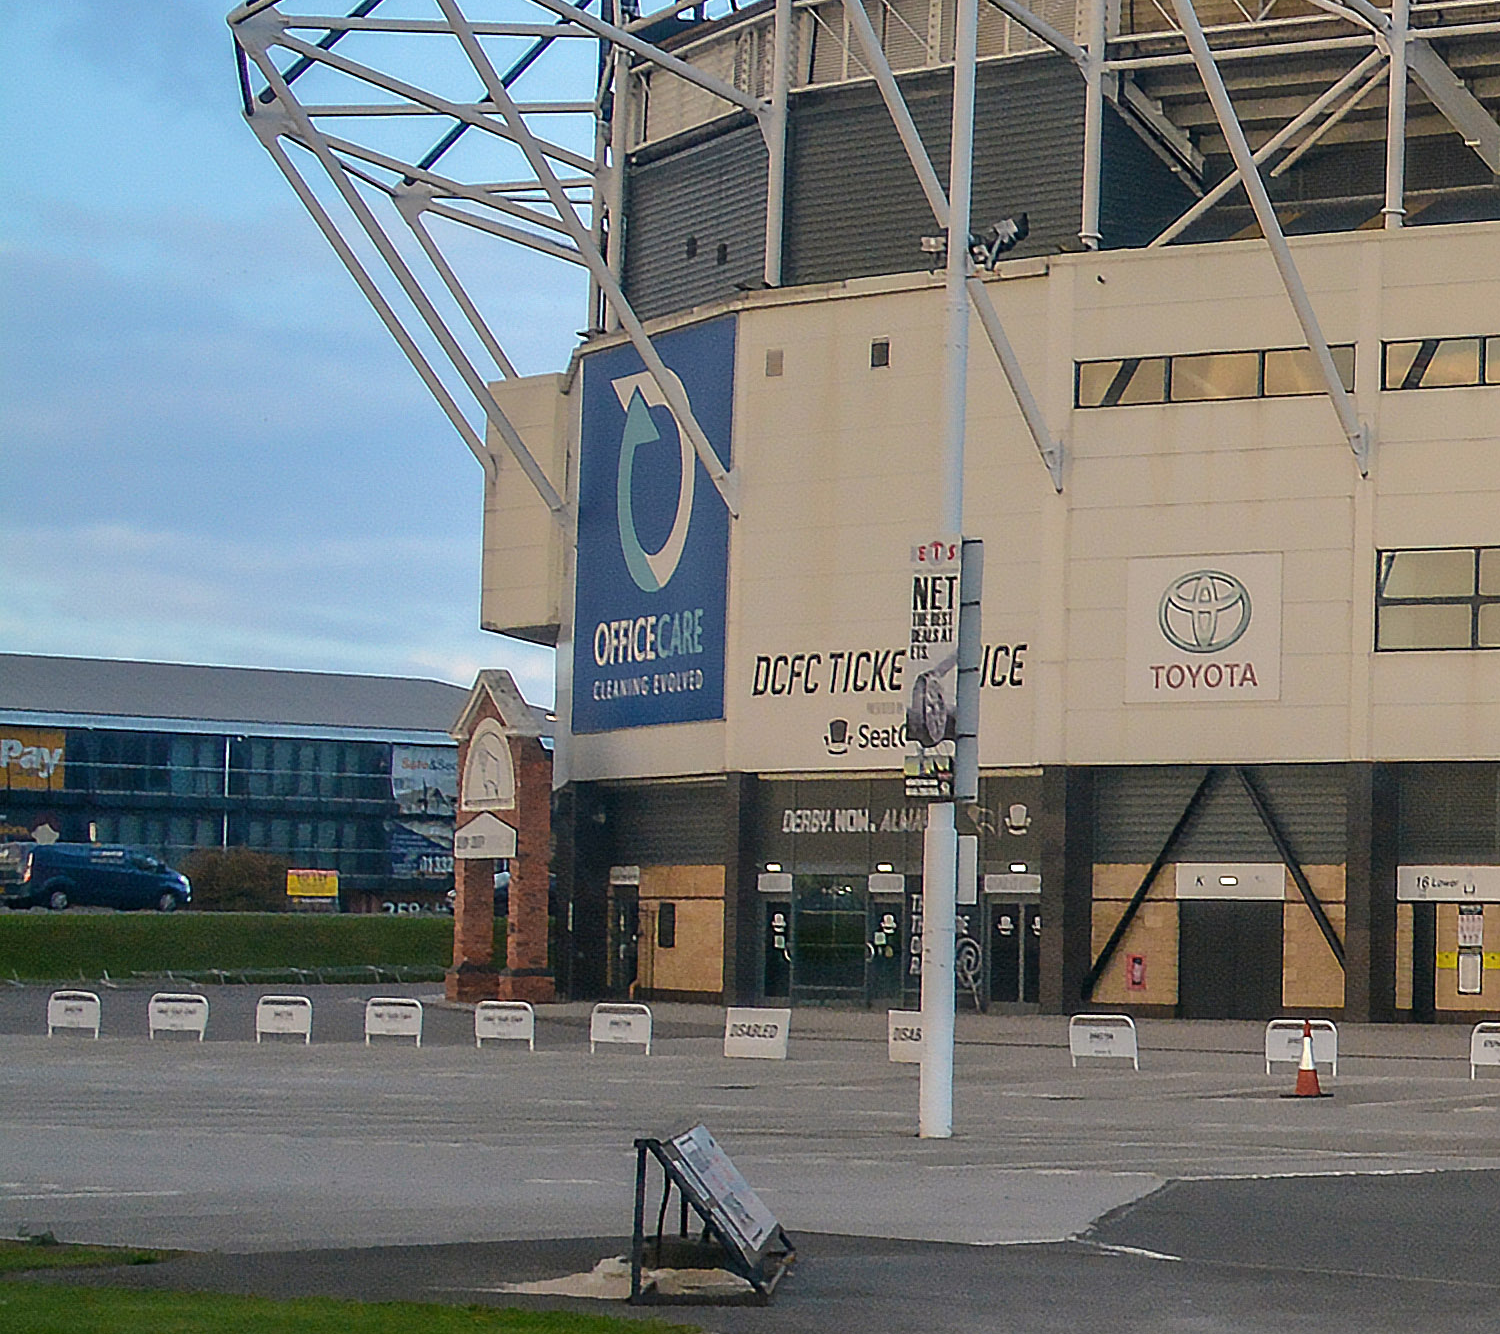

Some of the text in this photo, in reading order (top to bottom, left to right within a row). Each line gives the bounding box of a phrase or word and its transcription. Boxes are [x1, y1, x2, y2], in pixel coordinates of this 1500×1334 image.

[912, 575, 958, 611] NET
[594, 608, 704, 667] OFFICECARE
[593, 669, 704, 701] CLEANING EVOLVED
[752, 643, 1028, 697] DCFC TICKE ICE
[1149, 662, 1258, 690] TOYOTA
[1416, 875, 1430, 891] 16
[892, 1027, 922, 1042] DISAB
